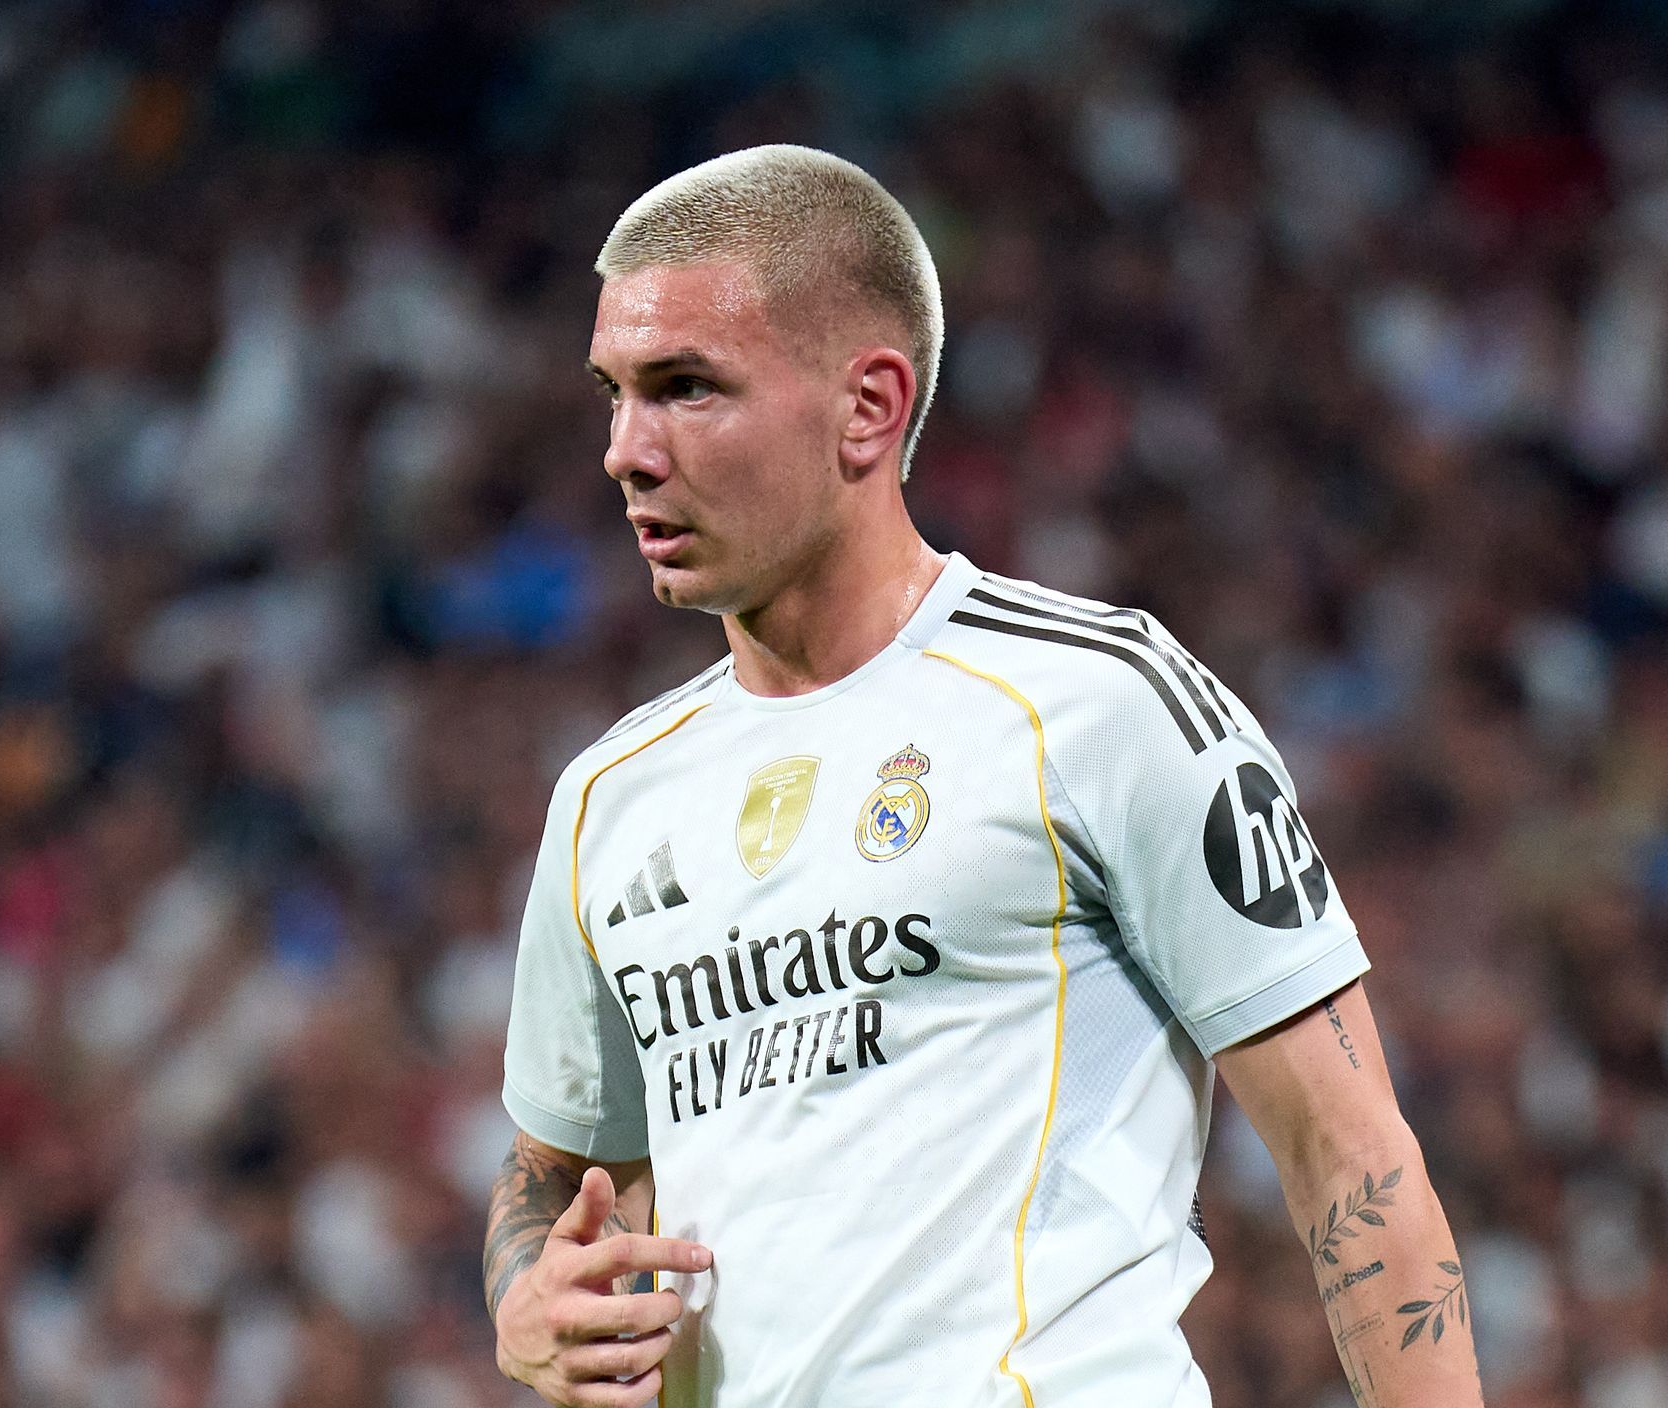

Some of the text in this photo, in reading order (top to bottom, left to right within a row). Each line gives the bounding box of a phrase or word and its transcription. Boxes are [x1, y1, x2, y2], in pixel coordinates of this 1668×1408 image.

[1211, 762, 1323, 929] hp
[613, 908, 941, 1049] Emirates
[668, 1000, 887, 1122] FLY BETTER
